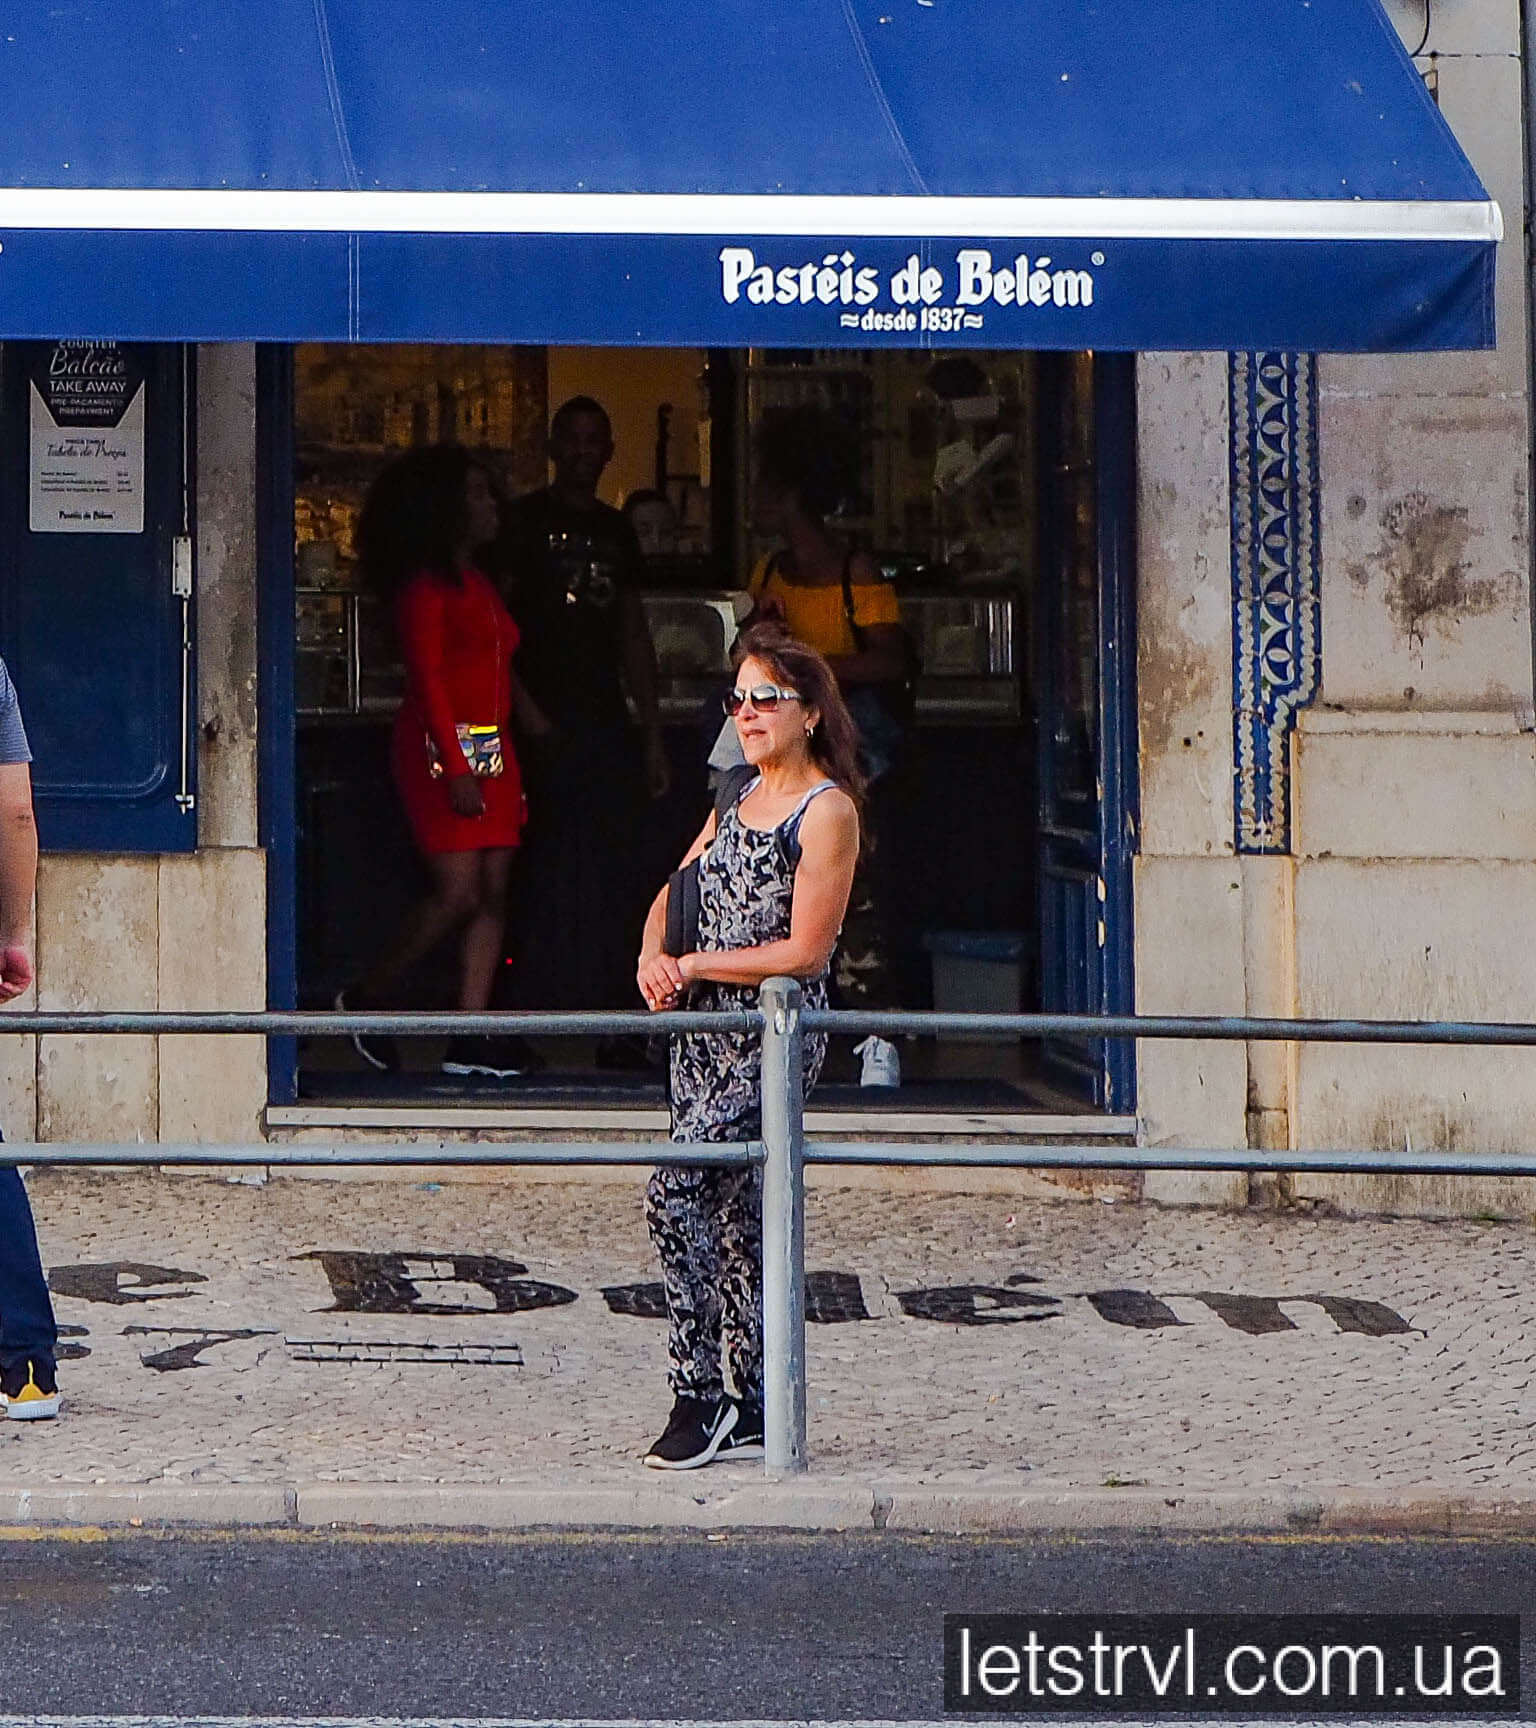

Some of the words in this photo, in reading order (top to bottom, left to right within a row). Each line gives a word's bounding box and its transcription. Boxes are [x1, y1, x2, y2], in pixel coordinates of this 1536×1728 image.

[718, 247, 879, 306] Pastéis
[890, 254, 943, 305] de
[920, 307, 965, 332] 1837
[50, 380, 83, 393] TAKE
[86, 380, 126, 393] AWAY
